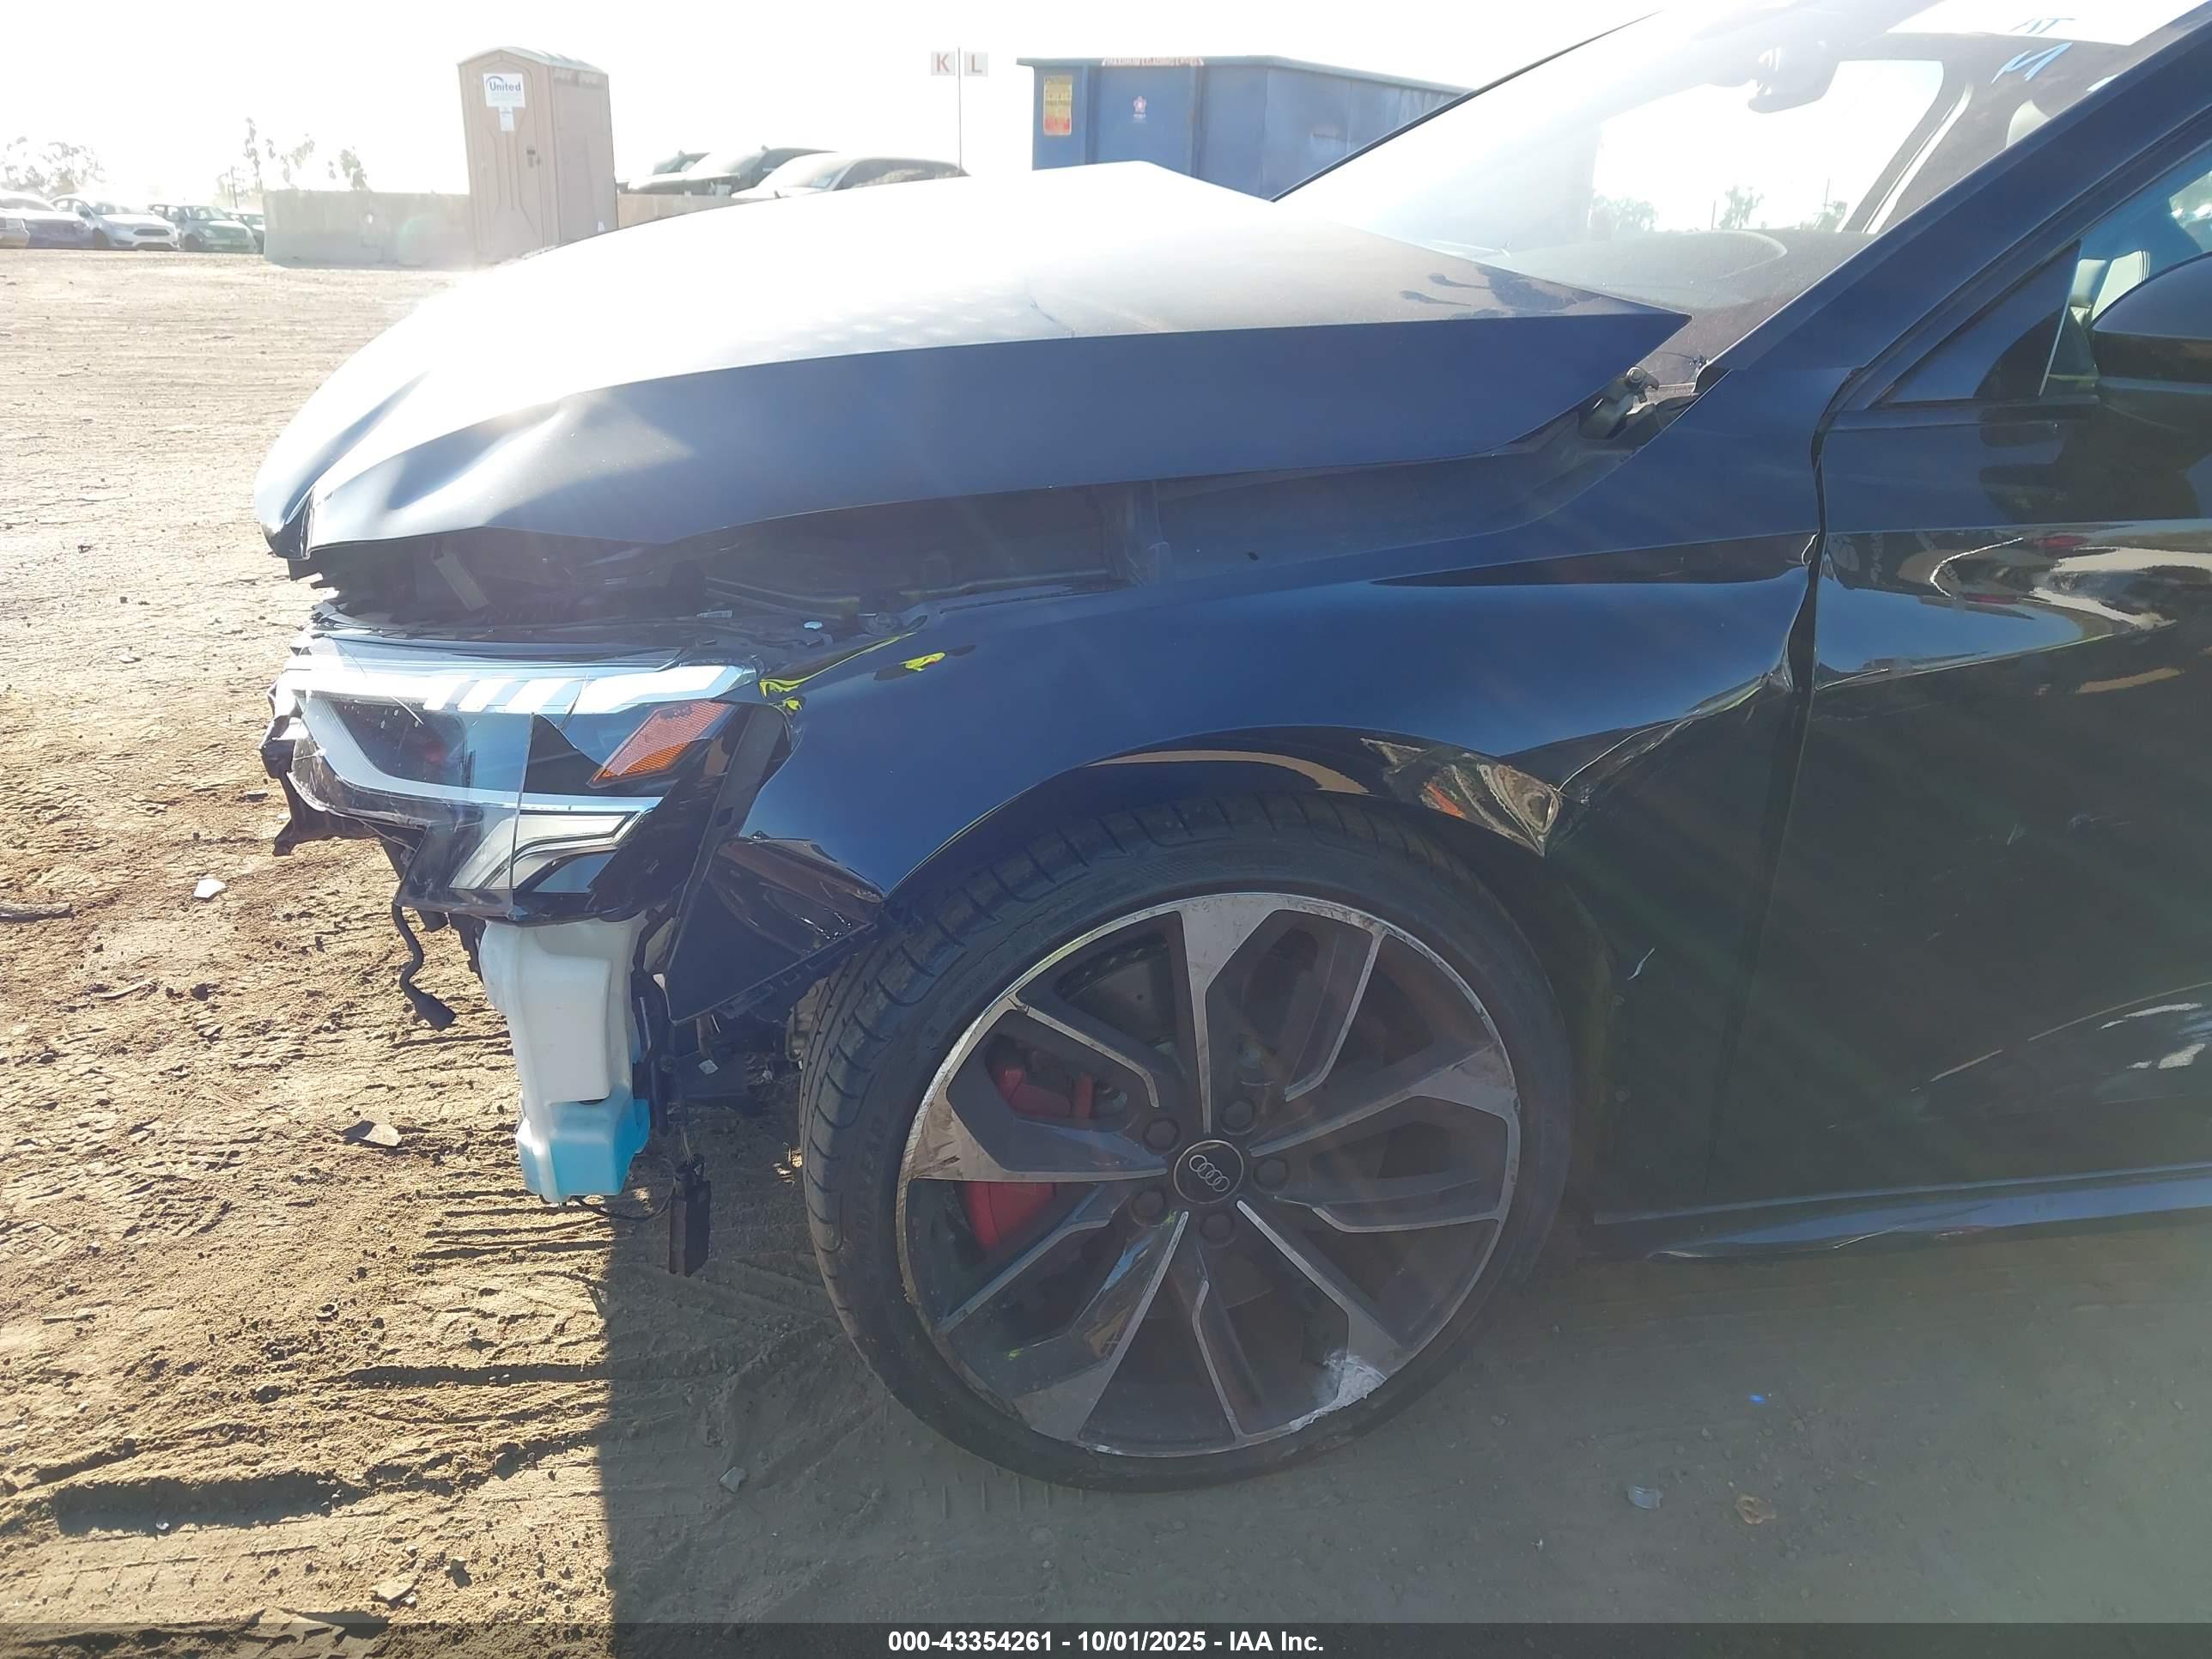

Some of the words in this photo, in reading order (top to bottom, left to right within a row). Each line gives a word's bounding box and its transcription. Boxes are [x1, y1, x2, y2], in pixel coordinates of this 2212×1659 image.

[936, 52, 950, 73] K
[970, 53, 983, 74] L
[489, 81, 521, 91] United
